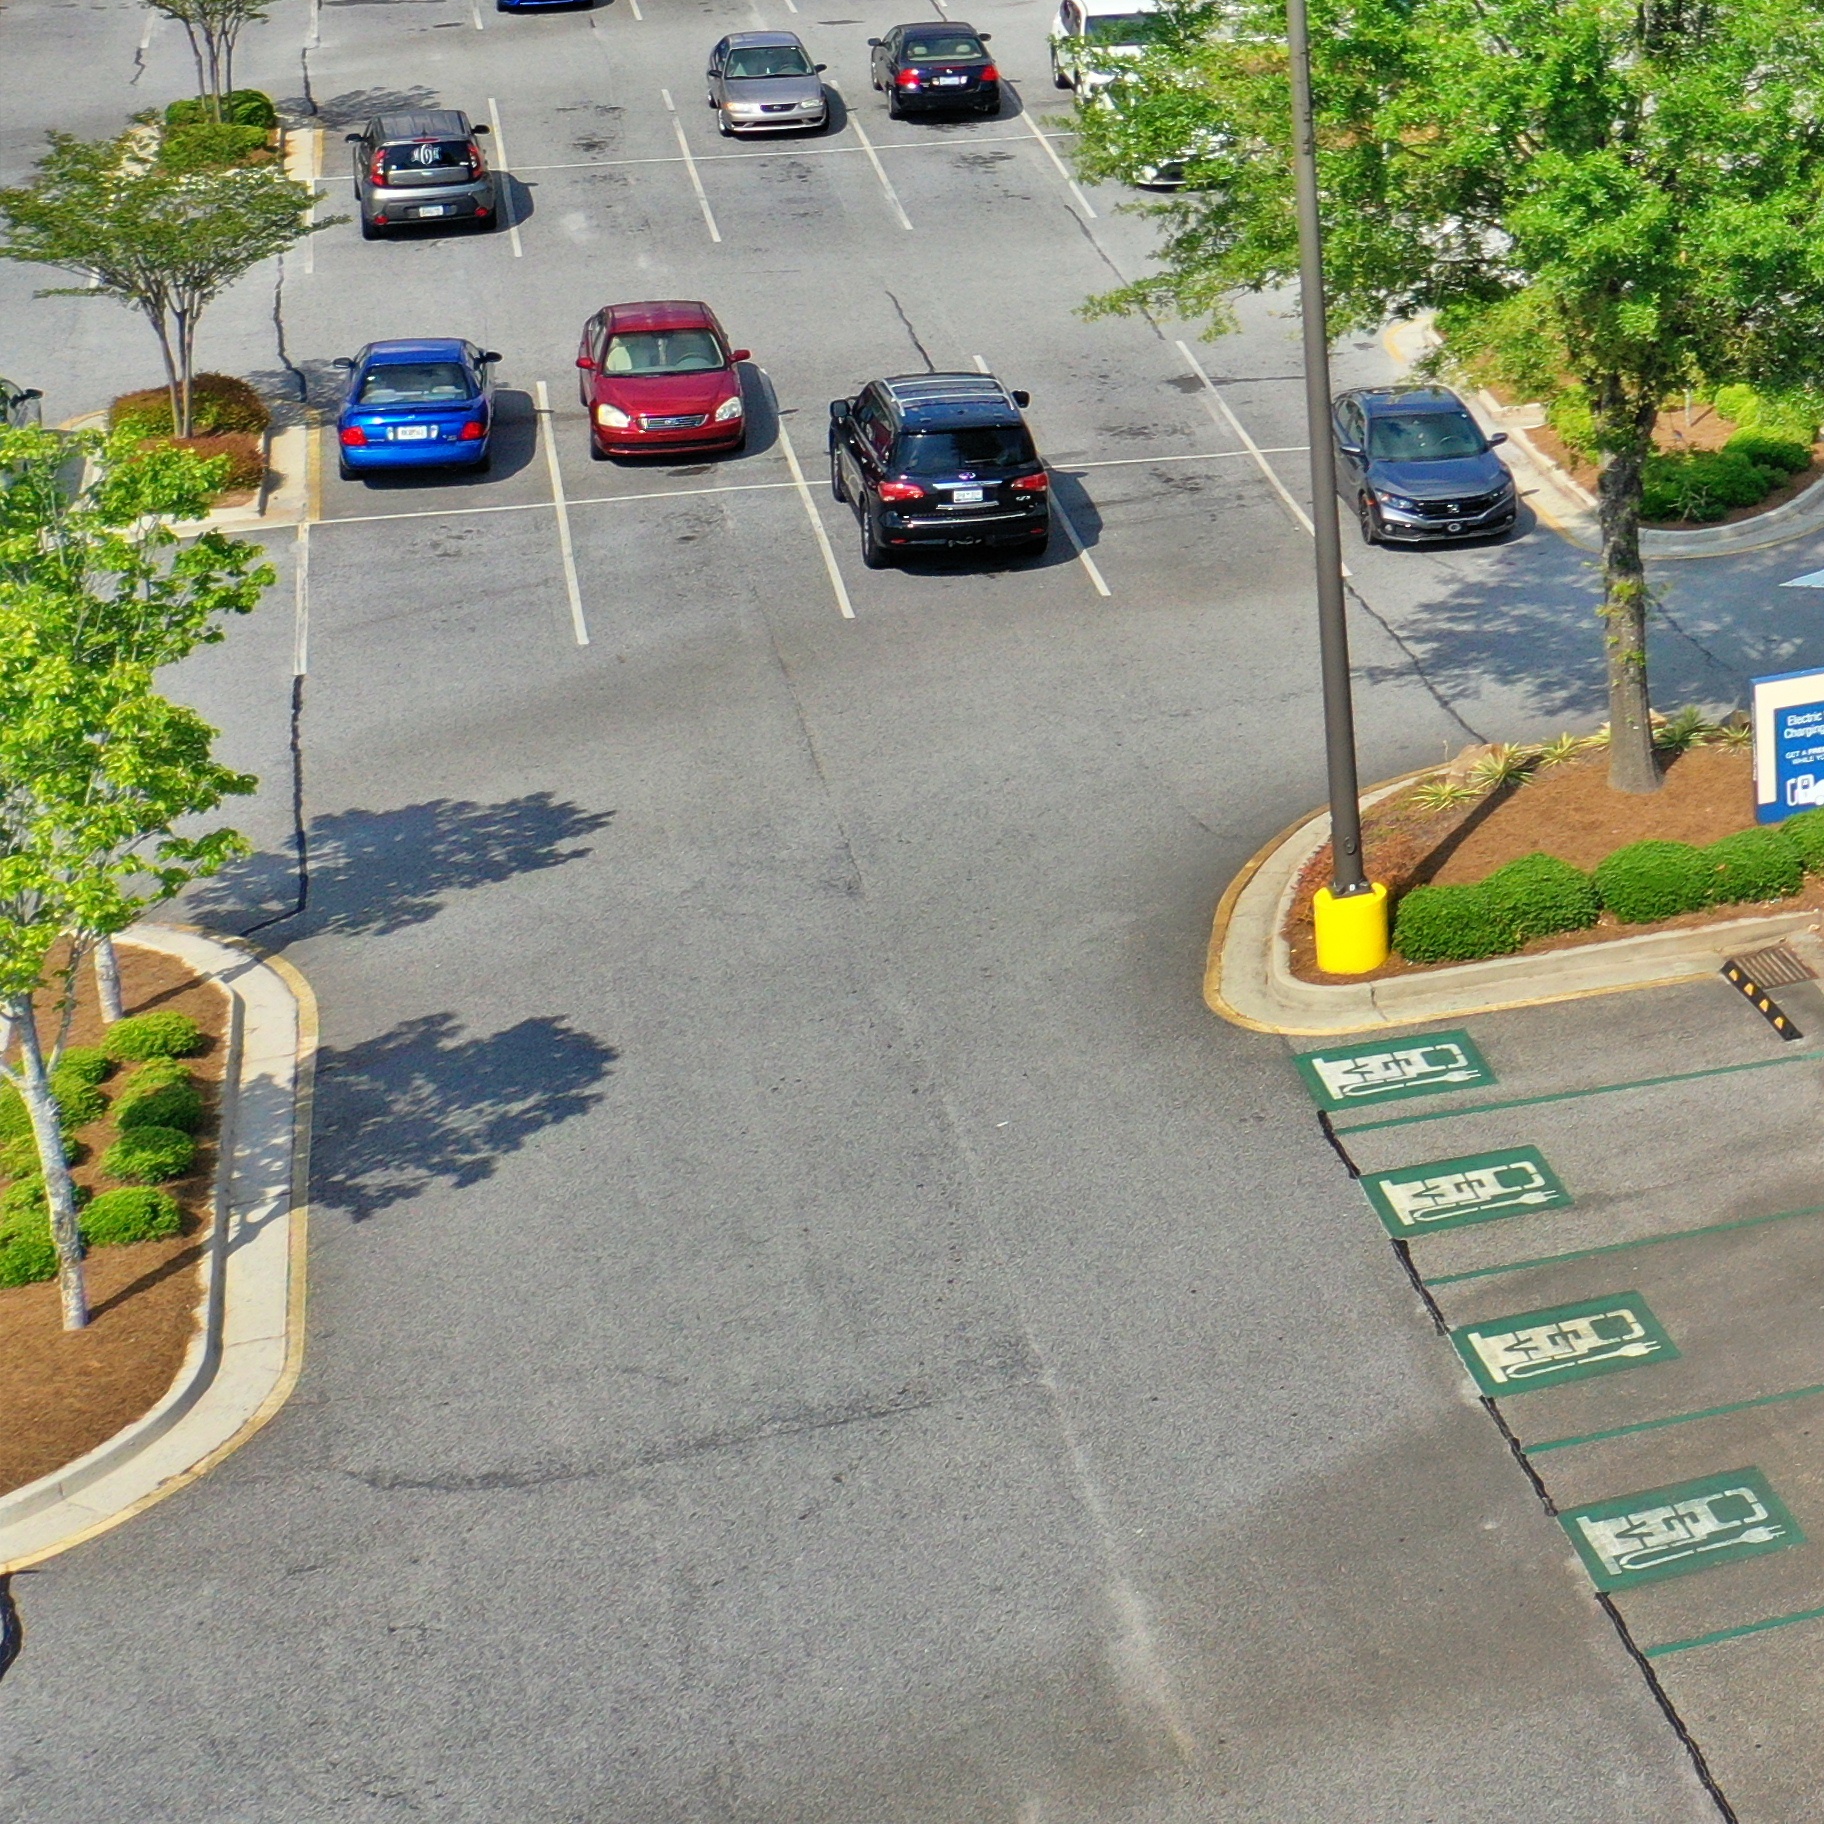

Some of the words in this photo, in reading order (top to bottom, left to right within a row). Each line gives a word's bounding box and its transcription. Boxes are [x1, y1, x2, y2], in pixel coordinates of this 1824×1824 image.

[1787, 712, 1822, 726] Electric
[1785, 751, 1800, 759] GET
[1792, 756, 1815, 765] WHILE
